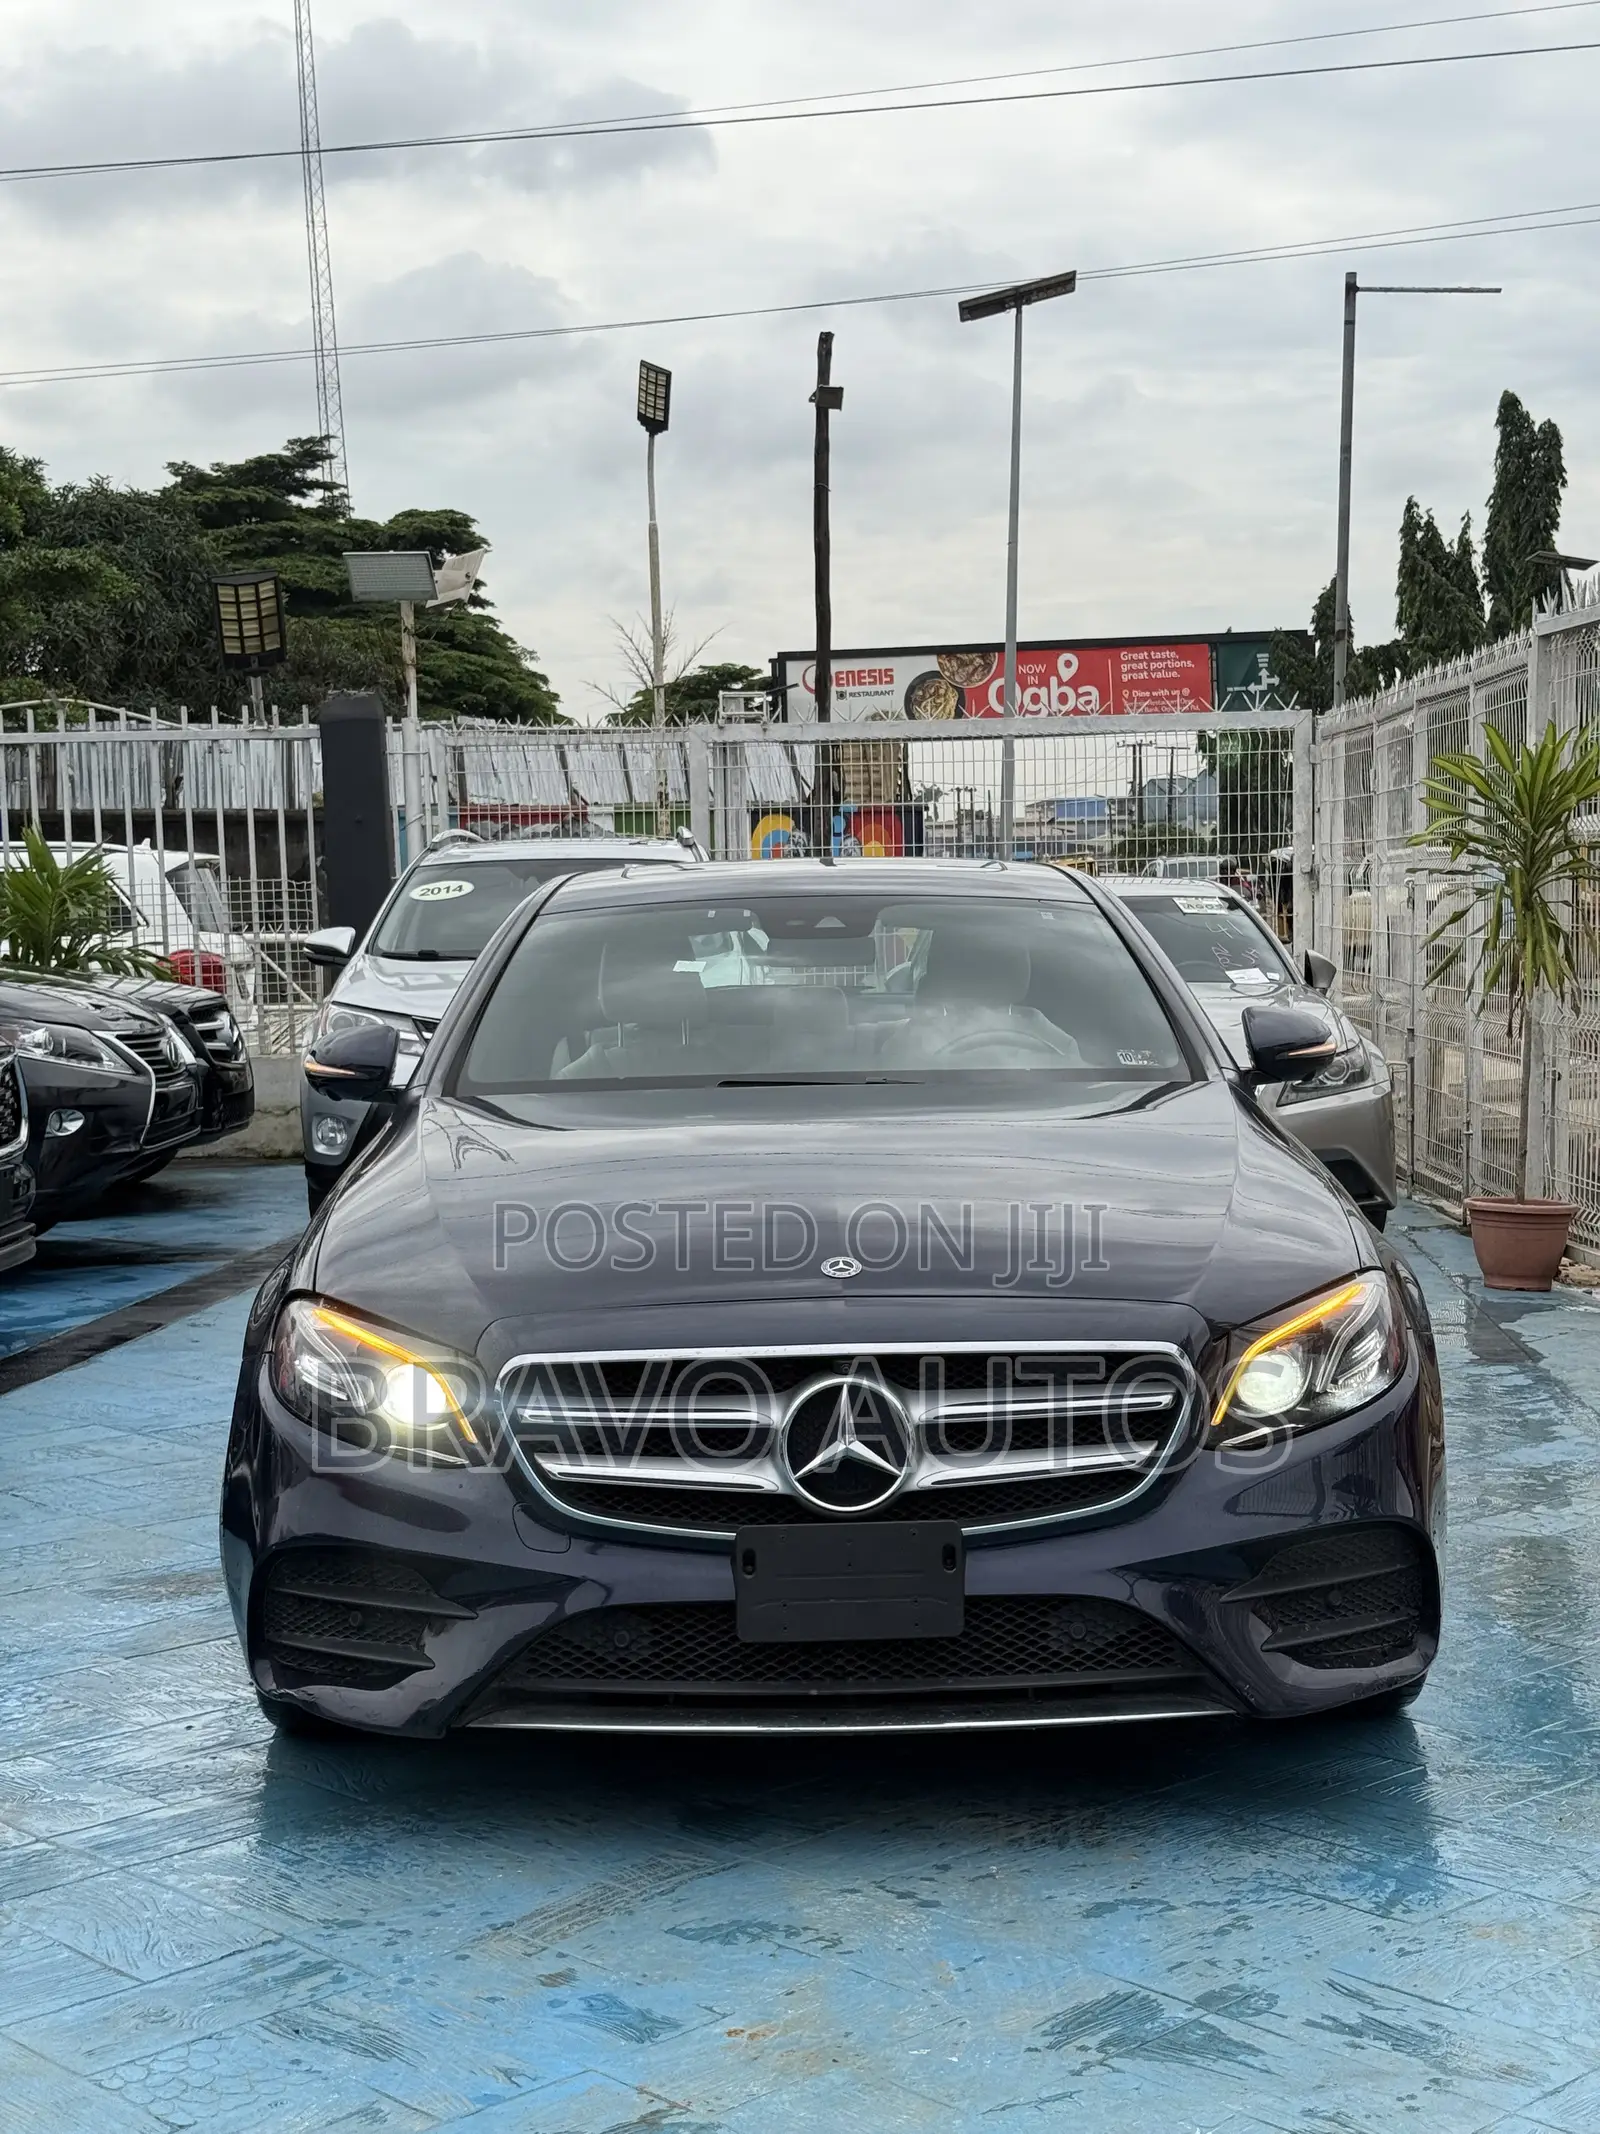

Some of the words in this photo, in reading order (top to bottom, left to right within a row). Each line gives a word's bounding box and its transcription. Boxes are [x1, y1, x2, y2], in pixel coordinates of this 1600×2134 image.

[1120, 651, 1149, 661] Great
[1150, 650, 1179, 660] taste,
[1018, 664, 1046, 674] NOW
[1121, 662, 1149, 672] great
[1150, 659, 1195, 671] portions,
[1027, 676, 1039, 685] IN
[1121, 672, 1149, 682] great
[1150, 669, 1181, 679] value.
[849, 690, 895, 698] RESTAURANT
[1132, 690, 1150, 698] Dine
[1152, 688, 1170, 697] with
[419, 884, 464, 897] 2014
[1119, 1052, 1133, 1063] 10
